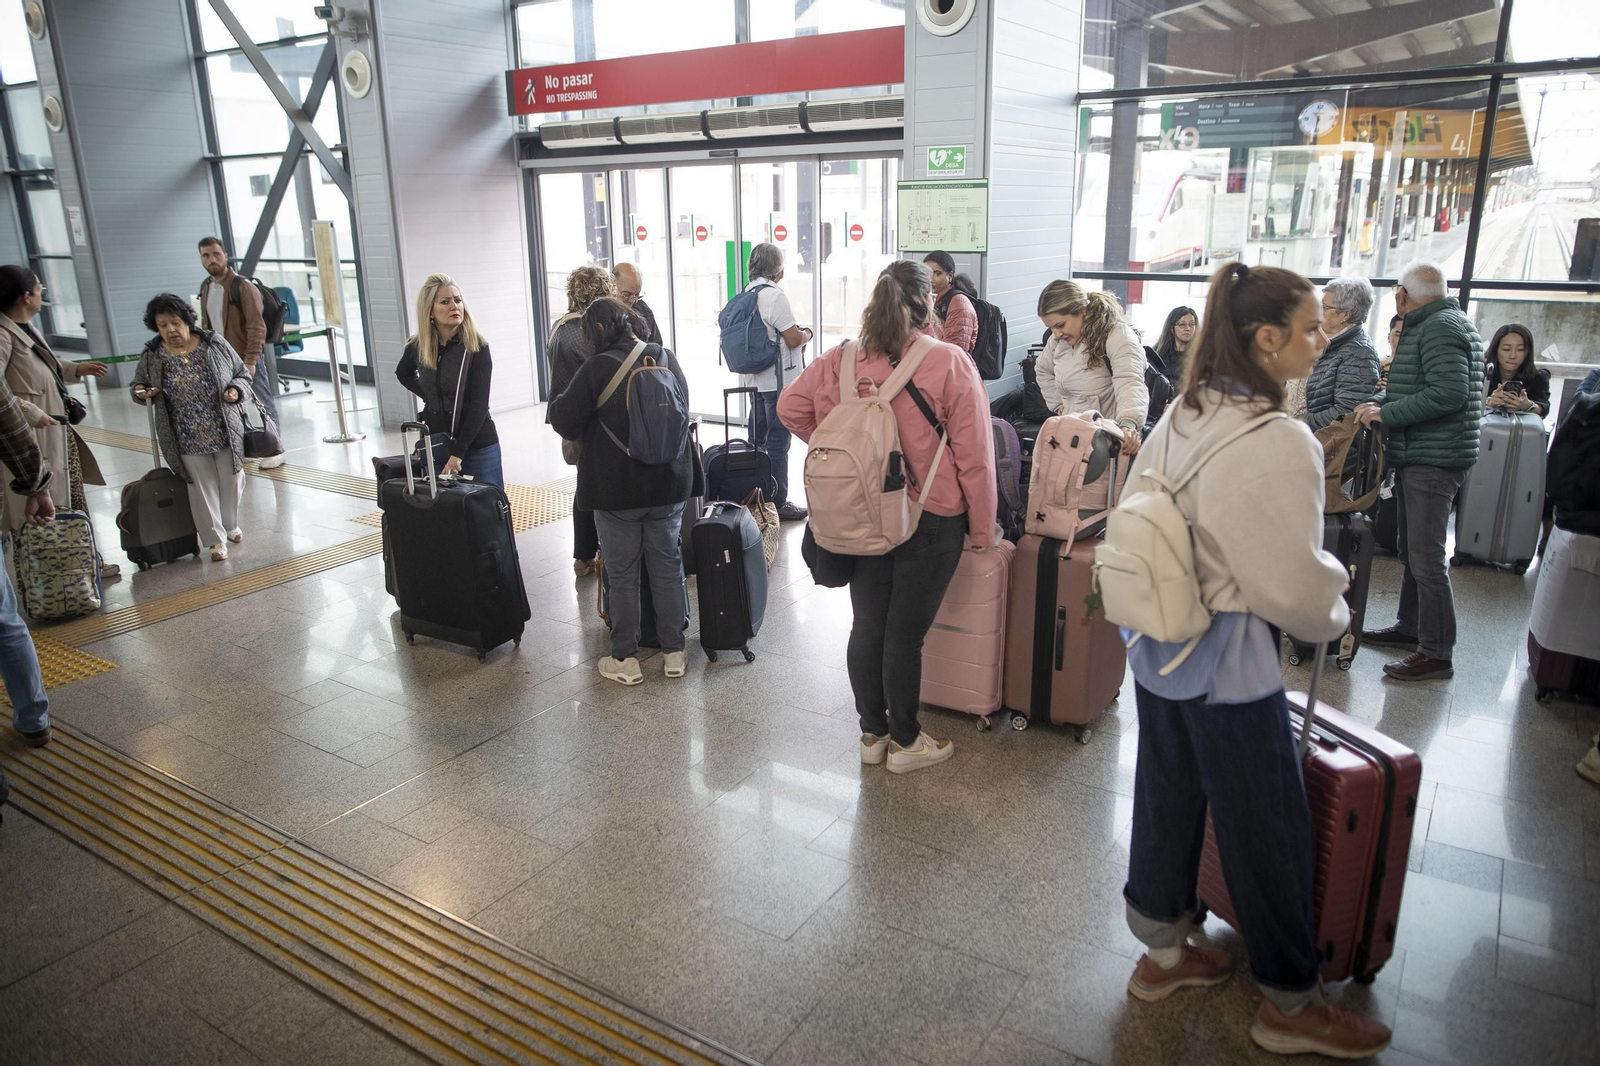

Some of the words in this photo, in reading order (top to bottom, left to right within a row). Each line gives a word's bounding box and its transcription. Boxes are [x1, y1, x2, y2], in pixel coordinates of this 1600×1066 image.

[545, 75, 559, 89] No
[562, 73, 593, 90] pasar
[546, 94, 556, 104] NO
[557, 90, 597, 102] TRESPASSING
[1197, 117, 1216, 125] Destino
[1173, 125, 1188, 144] 4
[1450, 133, 1466, 155] 4
[823, 161, 832, 175] 5
